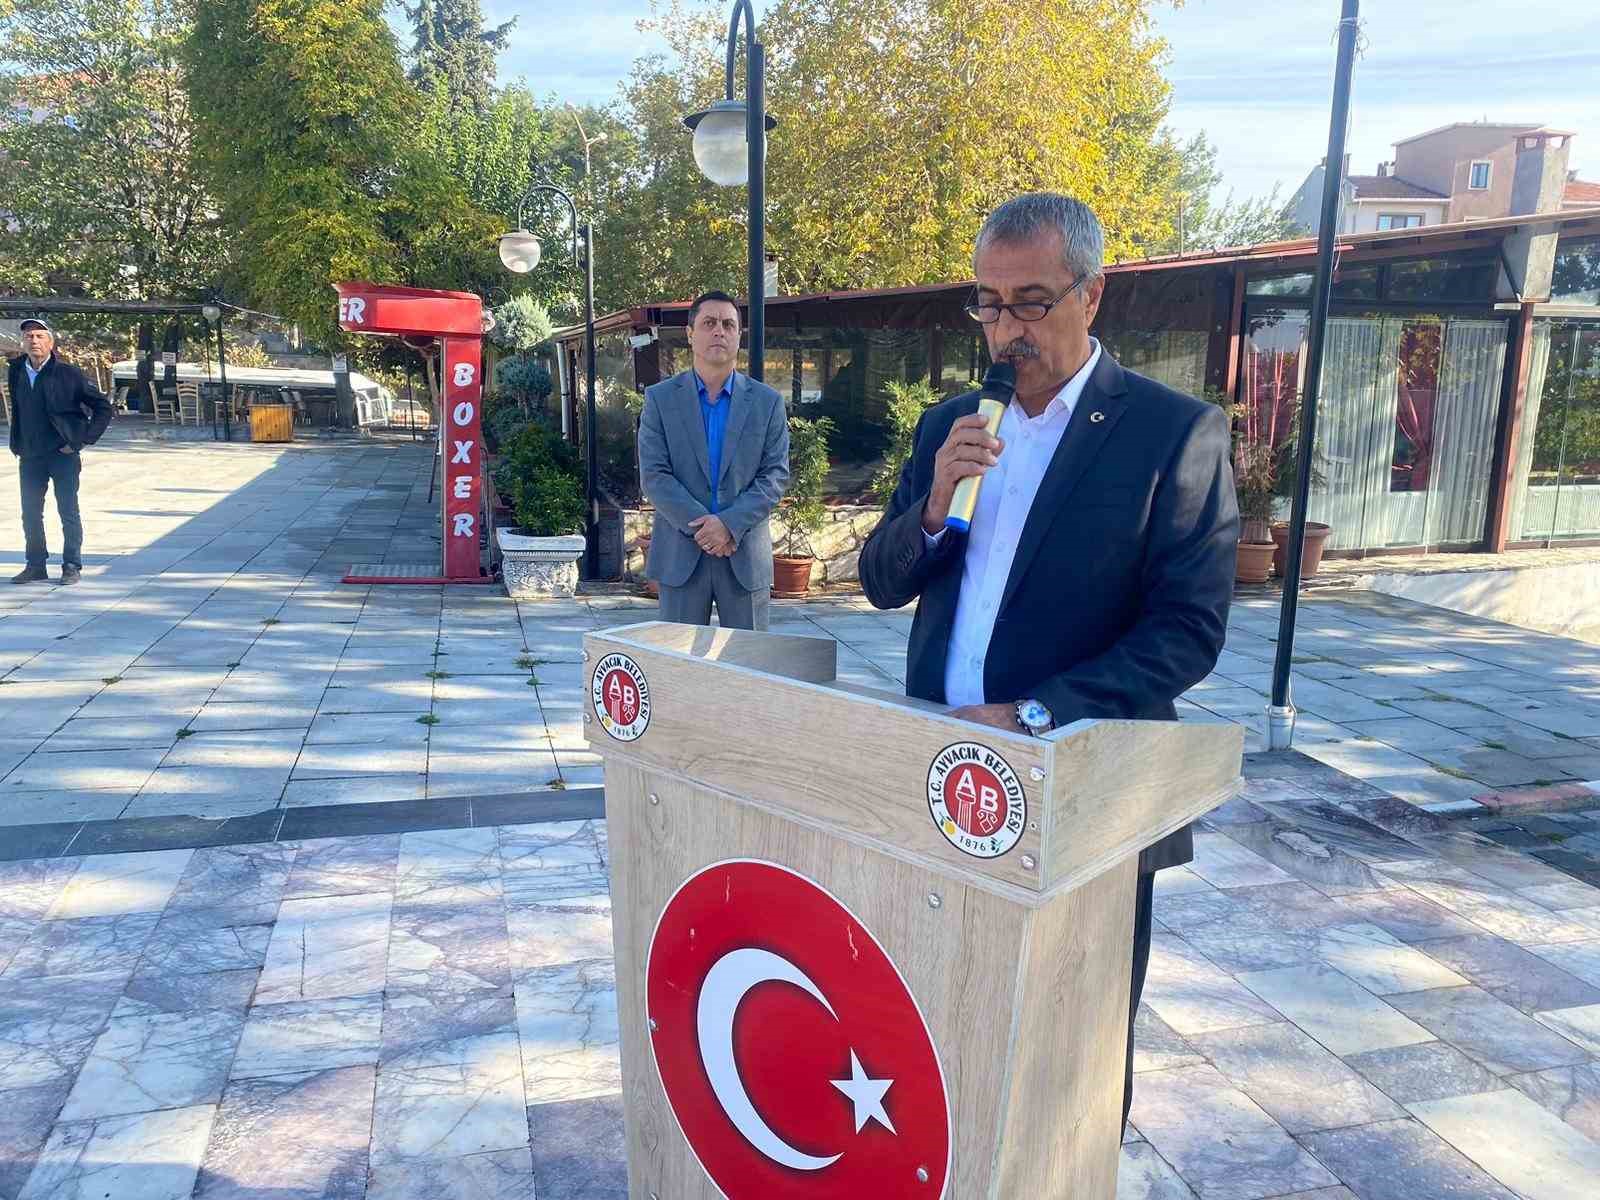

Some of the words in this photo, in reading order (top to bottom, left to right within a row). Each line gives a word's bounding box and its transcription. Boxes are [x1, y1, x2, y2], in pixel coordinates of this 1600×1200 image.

[451, 362, 475, 537] BOXER
[596, 656, 622, 680] AYVACIK
[935, 746, 981, 777] AYVACIK
[930, 780, 942, 806] T.C.
[985, 753, 1022, 834] BELEDİYESİ
[960, 836, 986, 851] 1876
